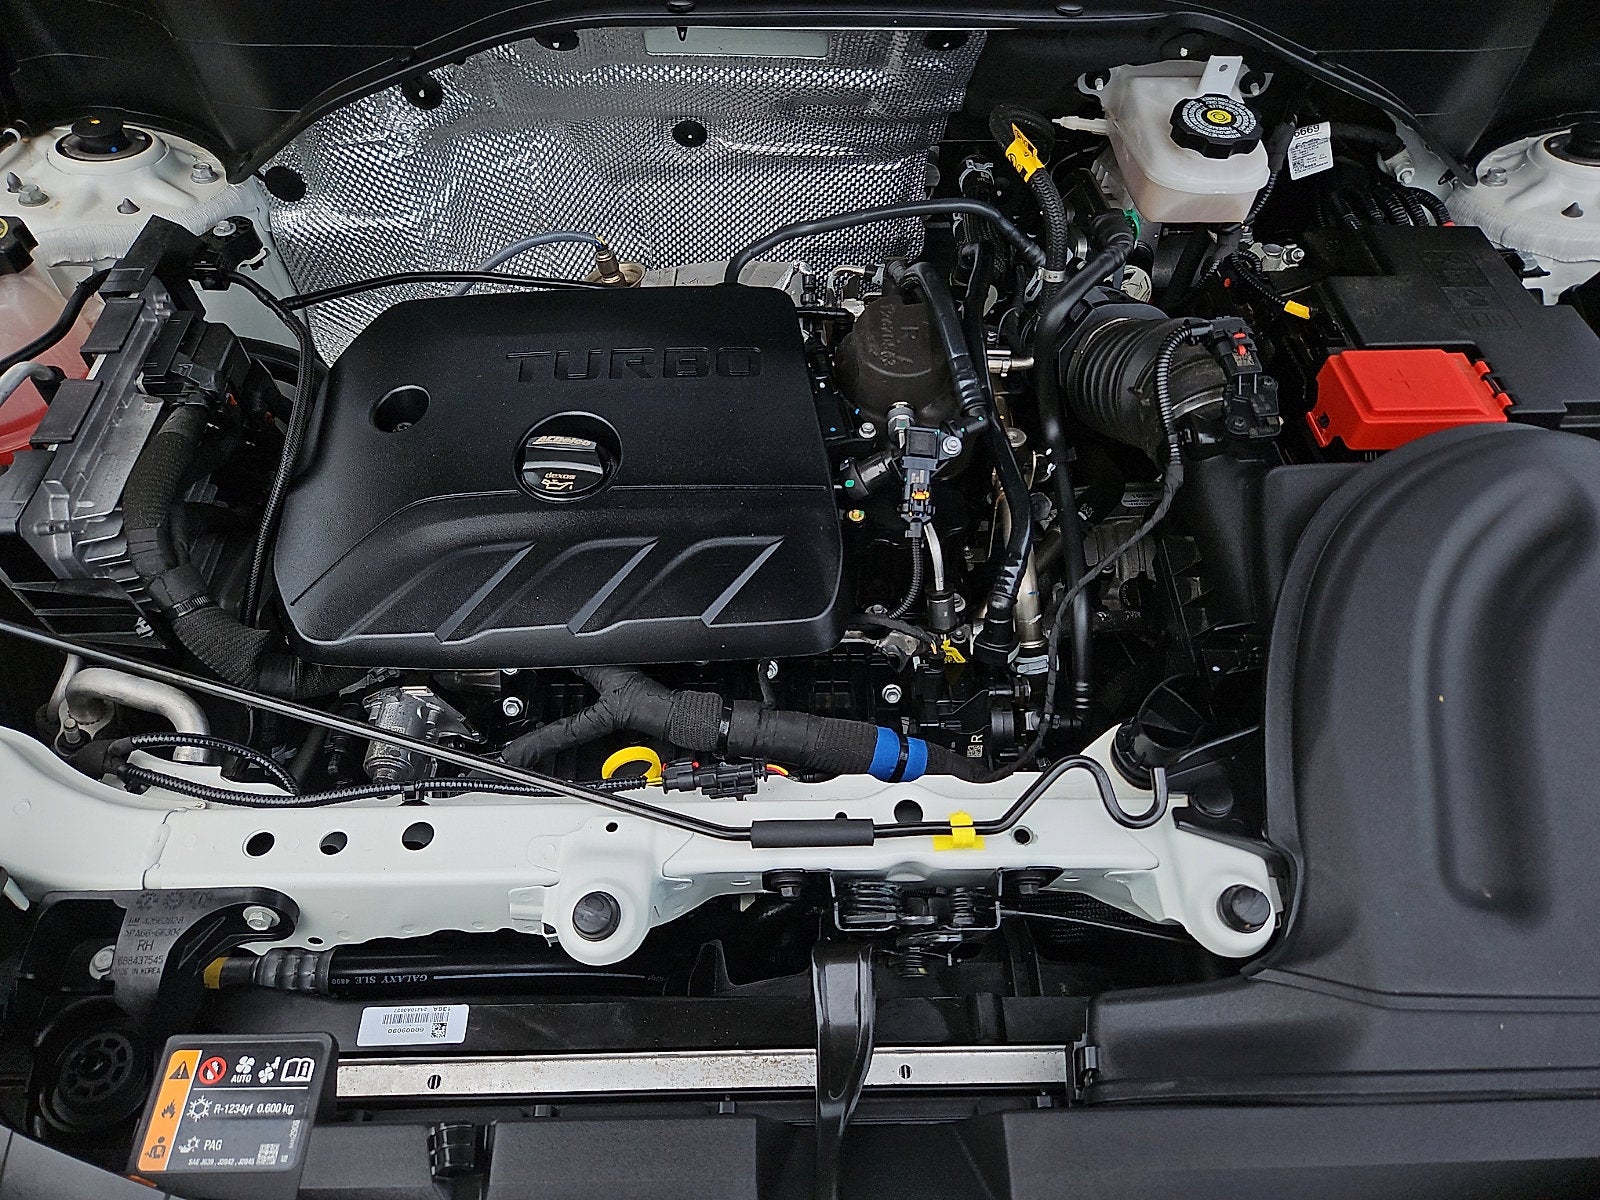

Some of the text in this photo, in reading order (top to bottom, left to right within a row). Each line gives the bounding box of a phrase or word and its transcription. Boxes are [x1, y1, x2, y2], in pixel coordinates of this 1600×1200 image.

[506, 347, 762, 383] TURBO
[532, 435, 592, 446] ACDelco
[545, 472, 577, 480] dexos
[970, 734, 984, 743] R
[137, 939, 155, 951] RH
[355, 976, 376, 984] SLE
[381, 974, 428, 984] GALAXY
[230, 1074, 253, 1083] AUTO
[213, 1103, 295, 1116] R-1234yf 0.600 kg
[203, 1139, 223, 1151] PAG
